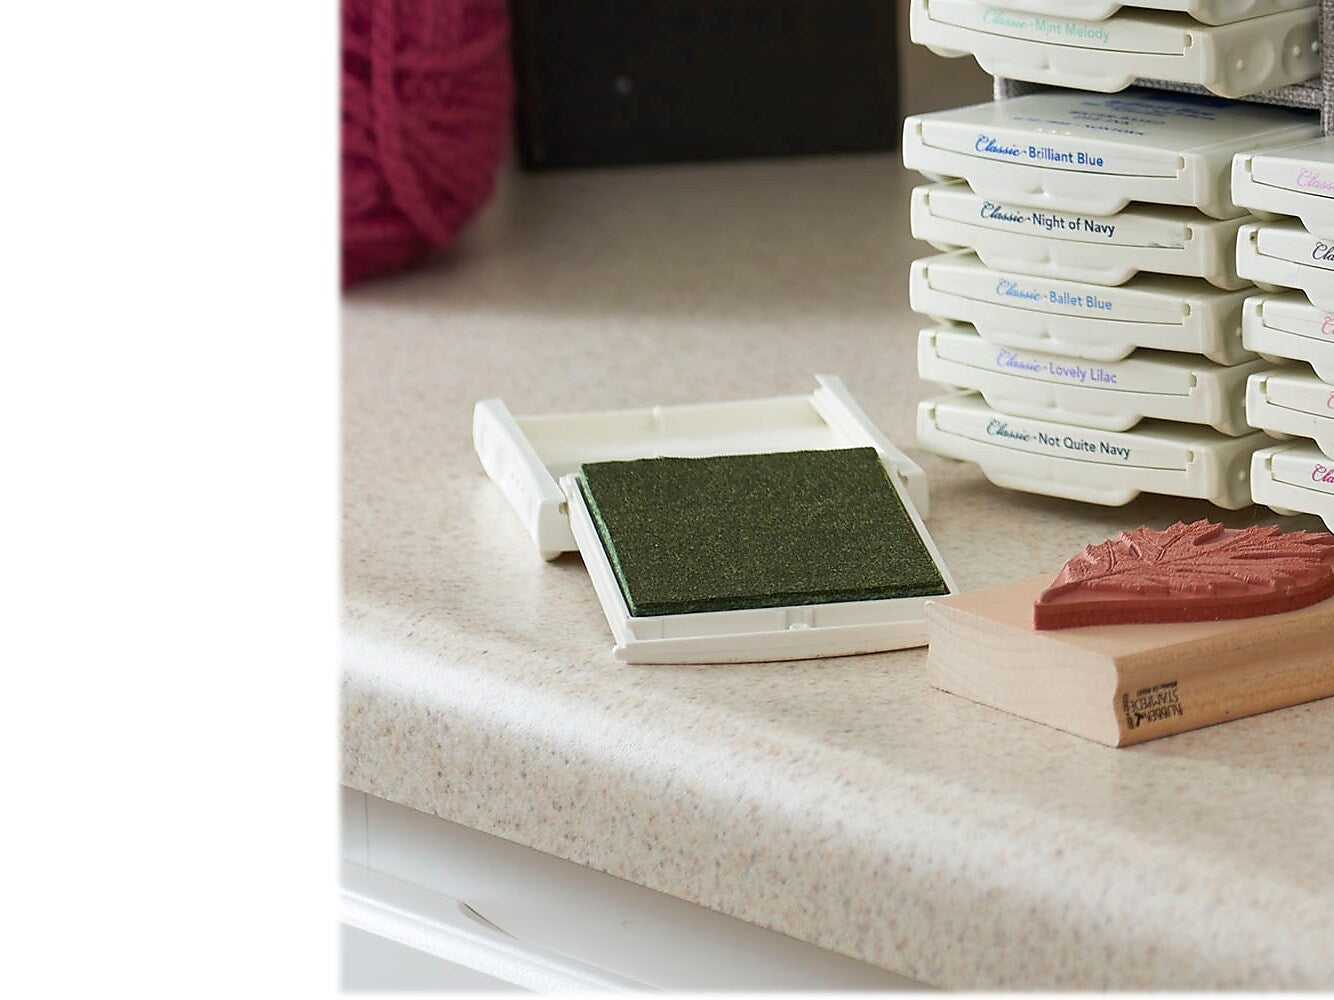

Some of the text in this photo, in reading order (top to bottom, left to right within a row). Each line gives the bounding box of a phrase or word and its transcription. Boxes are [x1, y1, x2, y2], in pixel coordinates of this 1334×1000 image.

[982, 7, 1110, 43] Classic Mint Melody
[975, 134, 1104, 167] Classic Brilliant Blue
[980, 201, 1115, 238] Classic Night of Navy
[995, 278, 1113, 311] Classic Ballet Blue
[996, 349, 1117, 384] Classic Lovely Lilac
[986, 419, 1131, 459] Classic Not Quite Navy
